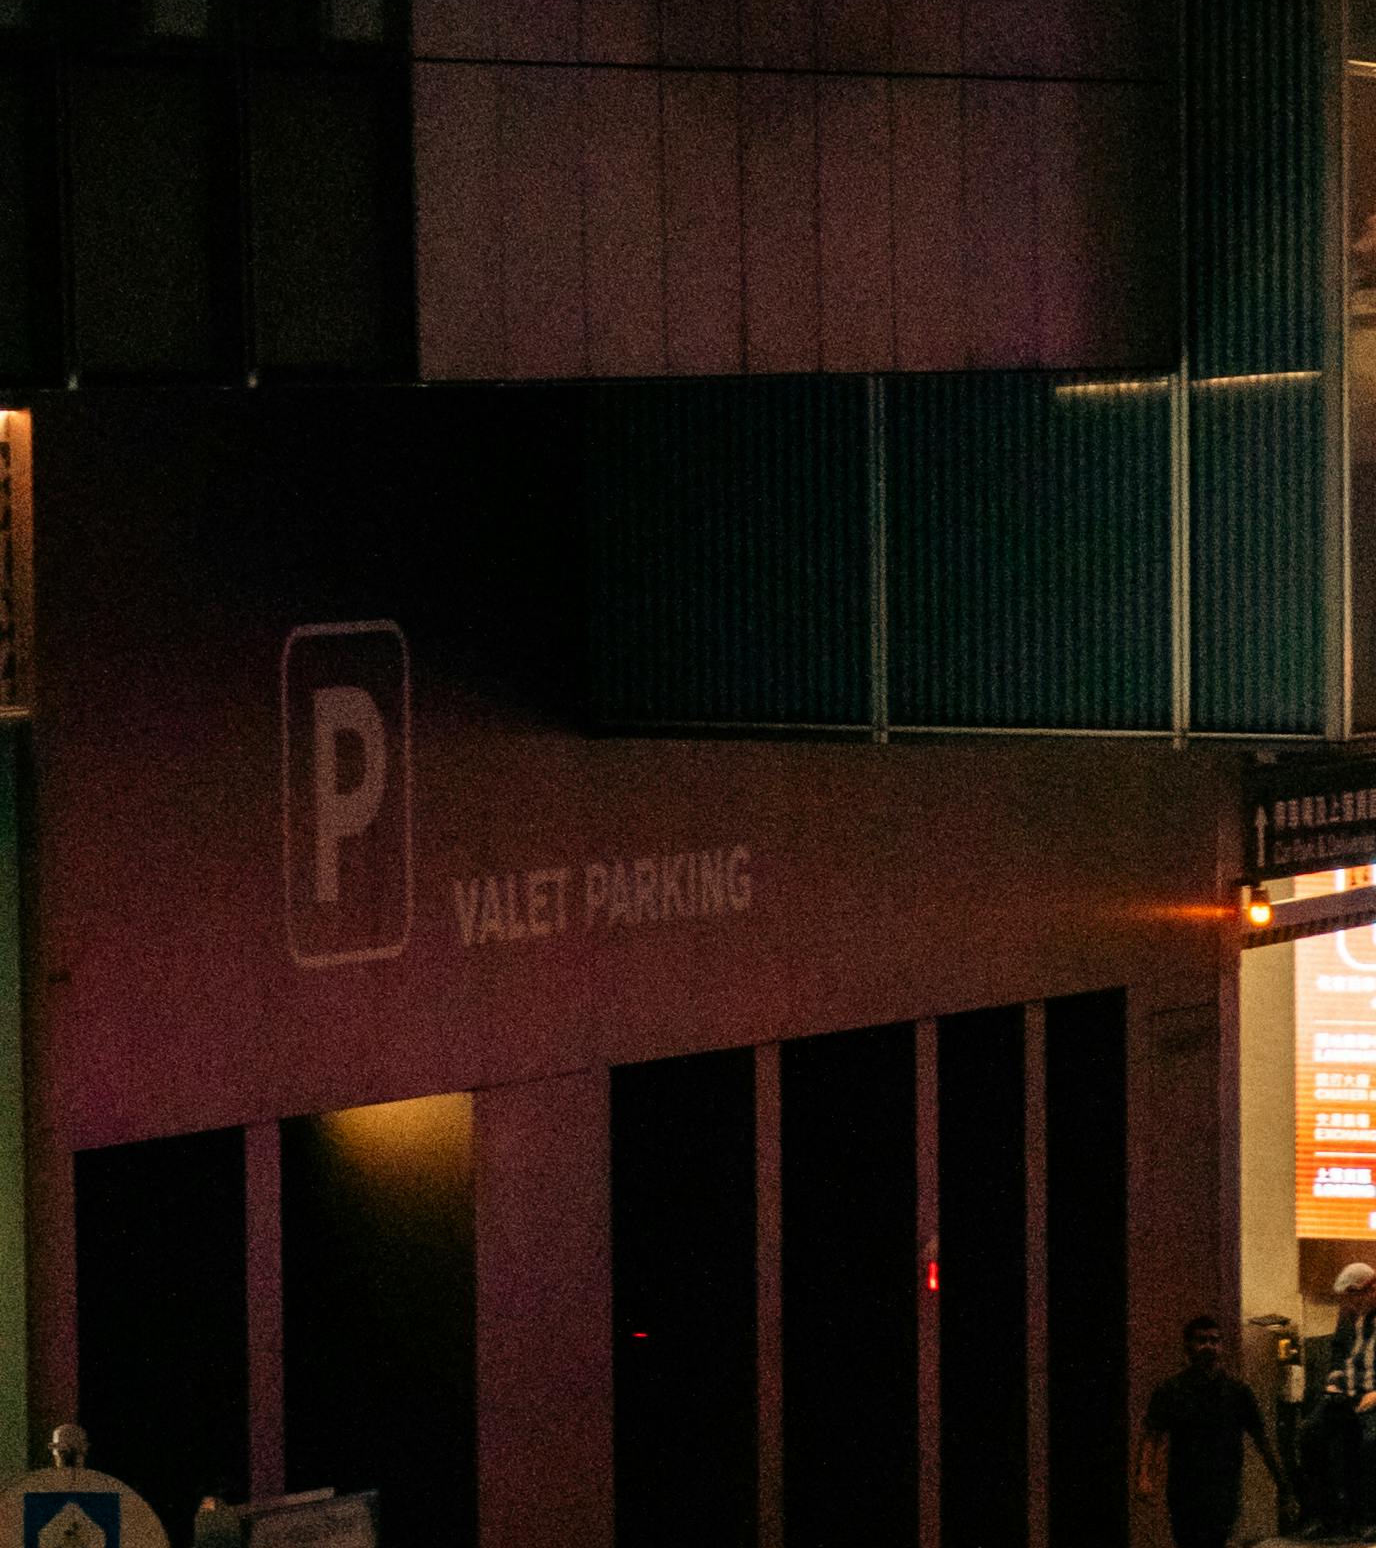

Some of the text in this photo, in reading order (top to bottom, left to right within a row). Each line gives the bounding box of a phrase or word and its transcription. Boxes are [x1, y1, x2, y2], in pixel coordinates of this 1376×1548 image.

[312, 685, 387, 902] P
[453, 843, 752, 947] VALET PARKING
